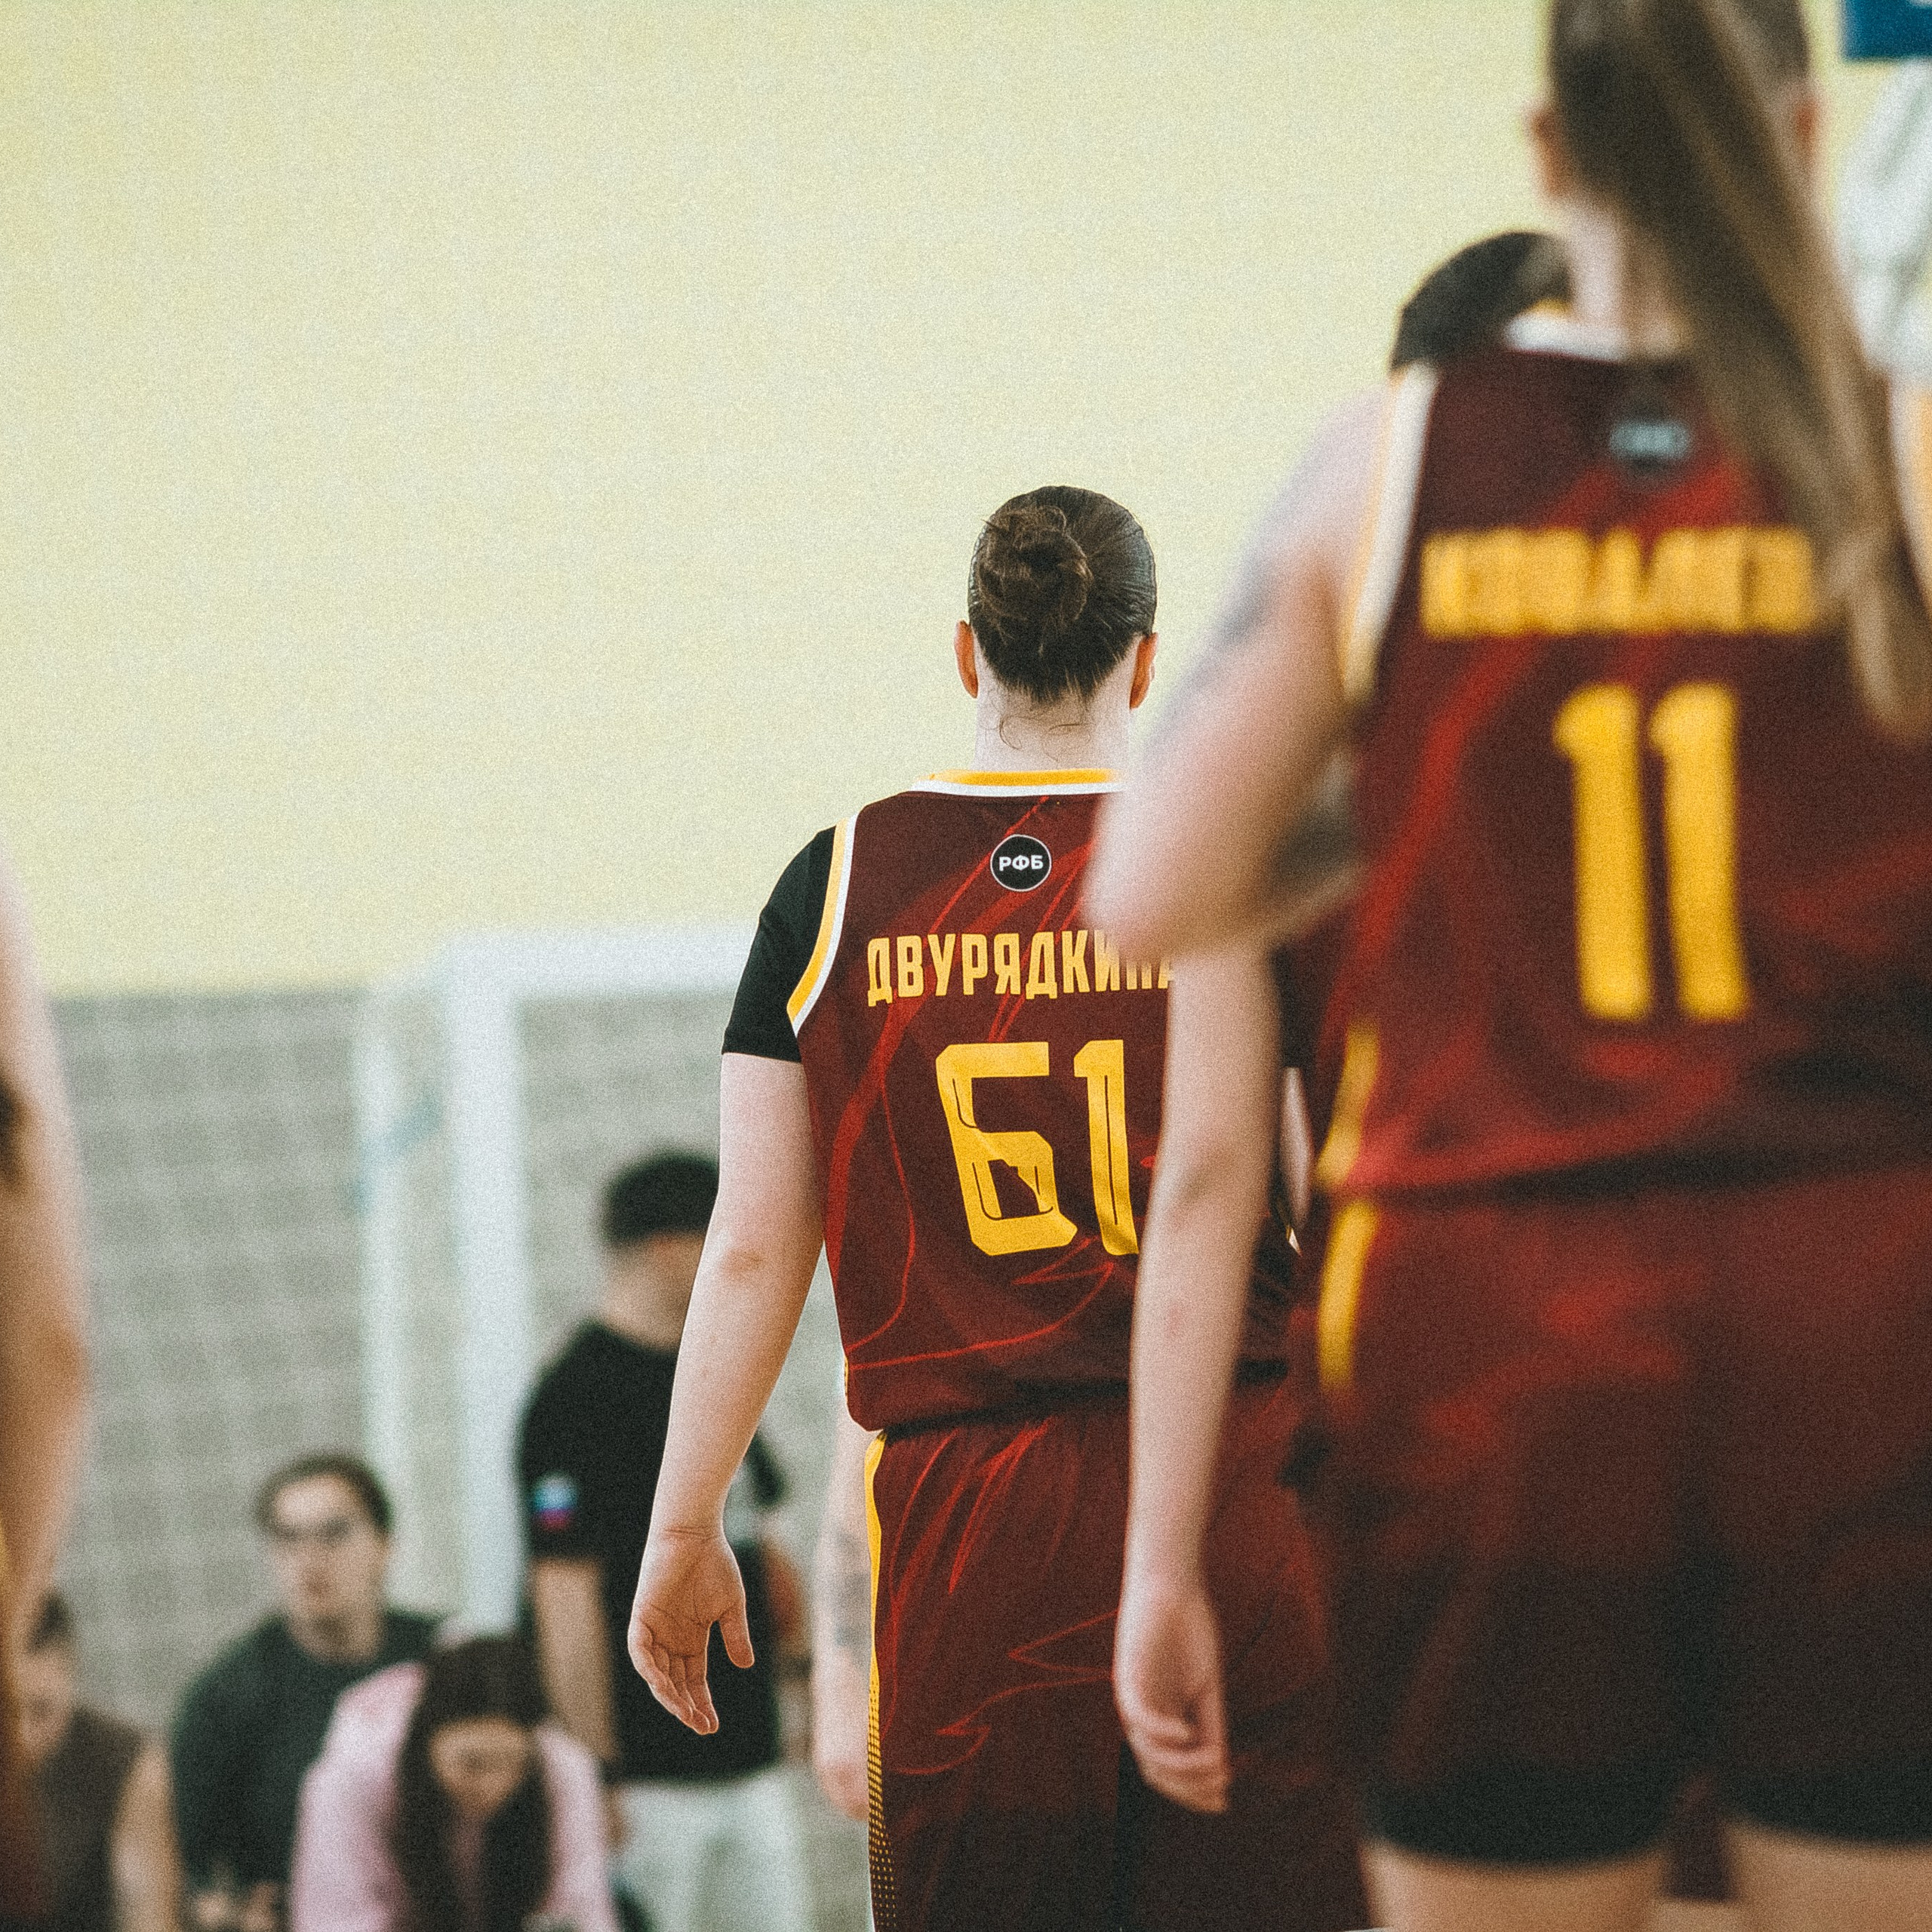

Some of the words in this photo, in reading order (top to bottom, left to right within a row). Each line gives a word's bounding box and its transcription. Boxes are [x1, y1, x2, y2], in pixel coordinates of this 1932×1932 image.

[998, 854, 1044, 872] РФБ
[1556, 685, 1749, 1020] 11
[936, 1039, 1139, 1256] 61
